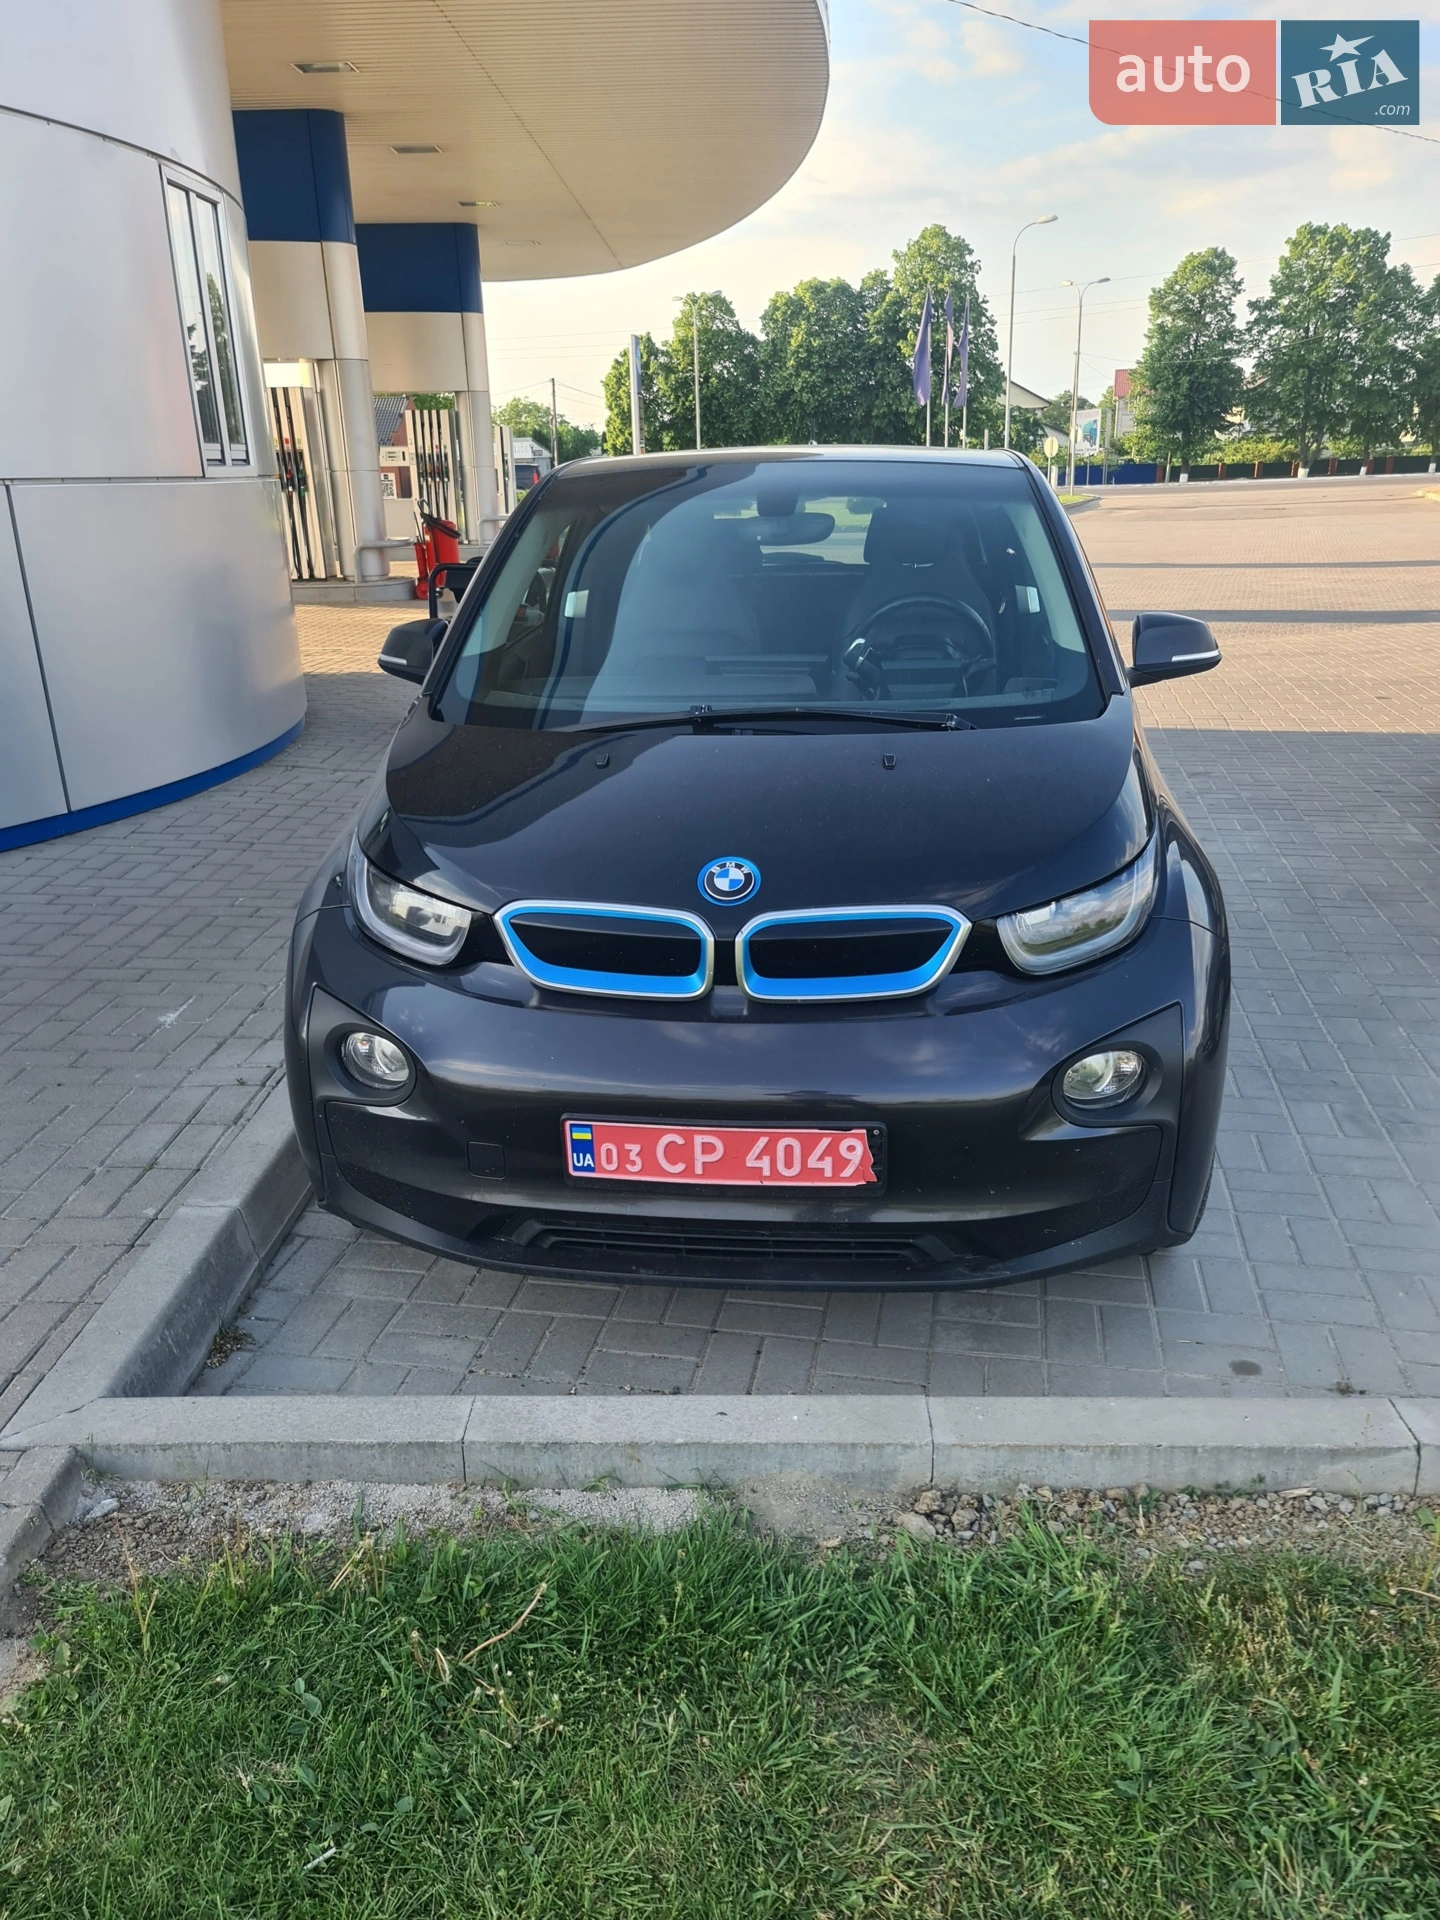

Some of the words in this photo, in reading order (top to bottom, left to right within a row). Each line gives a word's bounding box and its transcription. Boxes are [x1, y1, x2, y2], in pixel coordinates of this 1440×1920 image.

[710, 861, 751, 873] BMW
[572, 1153, 595, 1168] UA
[600, 1142, 643, 1172] 03
[656, 1134, 725, 1175] CP
[745, 1136, 864, 1178] 4049
